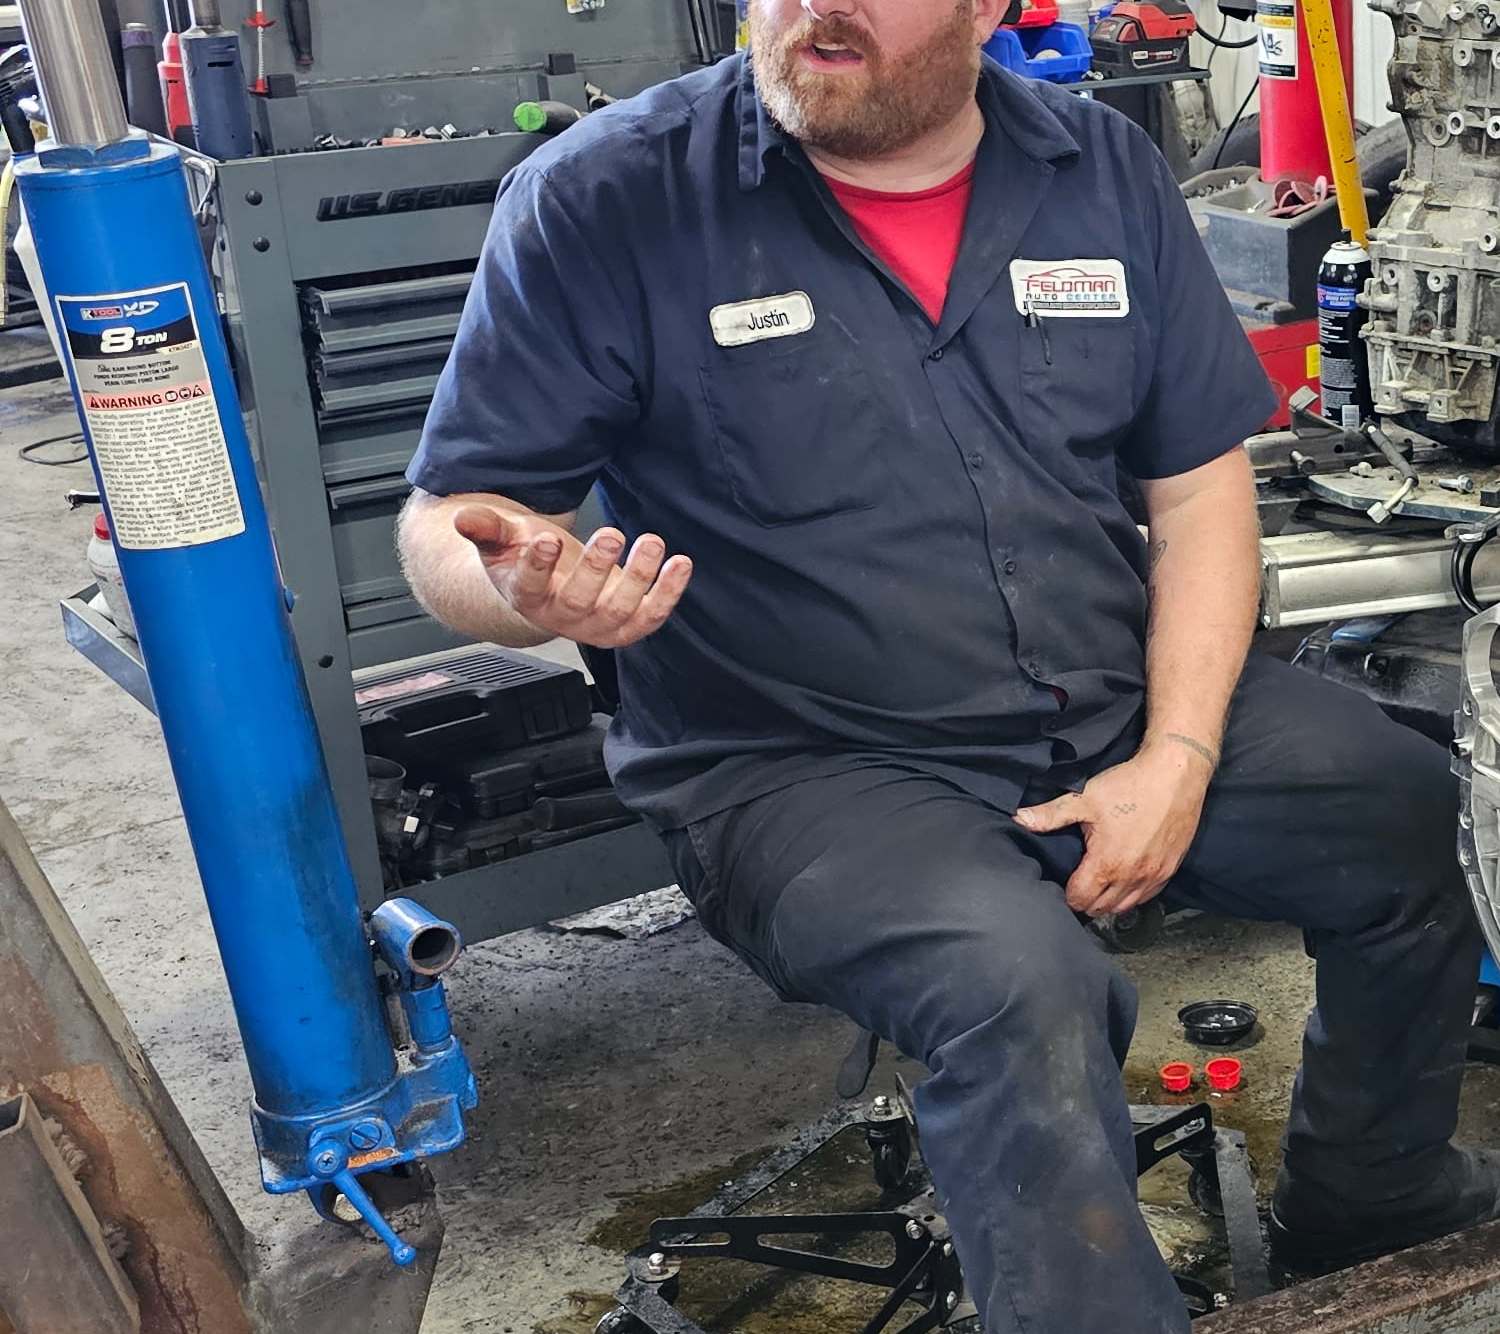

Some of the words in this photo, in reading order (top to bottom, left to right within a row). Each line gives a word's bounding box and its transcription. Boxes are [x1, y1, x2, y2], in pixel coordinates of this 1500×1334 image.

[1026, 279, 1116, 292] FELDMAN
[748, 309, 790, 330] Justin
[101, 327, 135, 353] 8
[136, 332, 168, 345] TON
[99, 394, 163, 408] WARNING
